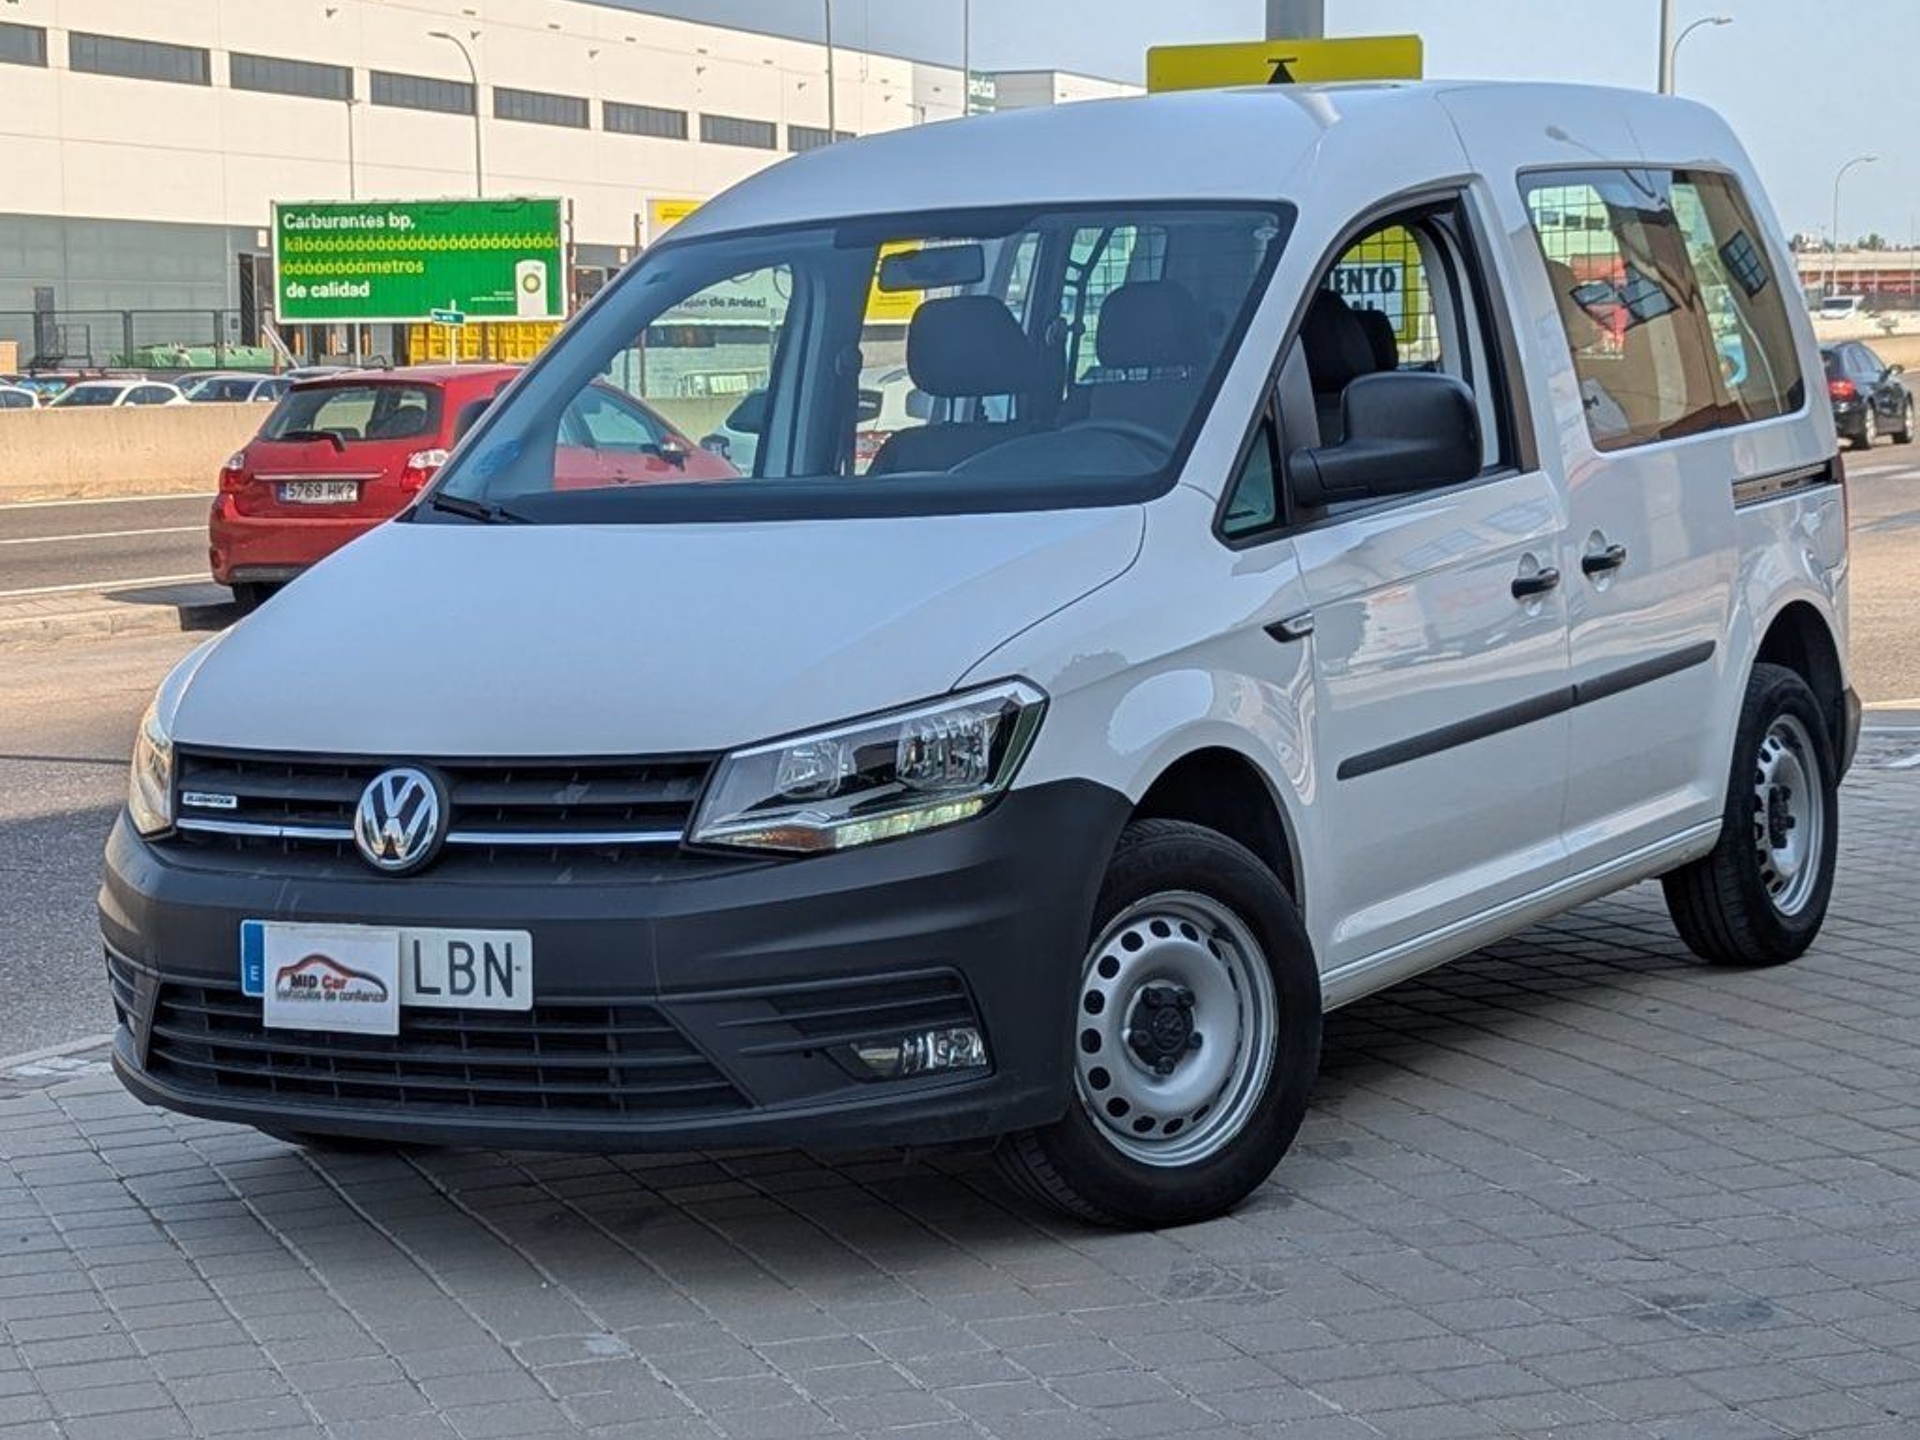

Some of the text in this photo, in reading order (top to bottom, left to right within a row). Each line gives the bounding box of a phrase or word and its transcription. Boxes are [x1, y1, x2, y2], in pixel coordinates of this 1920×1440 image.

[283, 211, 415, 231] Carburantes bp,
[286, 280, 370, 297] de calidad
[413, 939, 513, 999] LBN
[290, 974, 347, 990] MID Car
